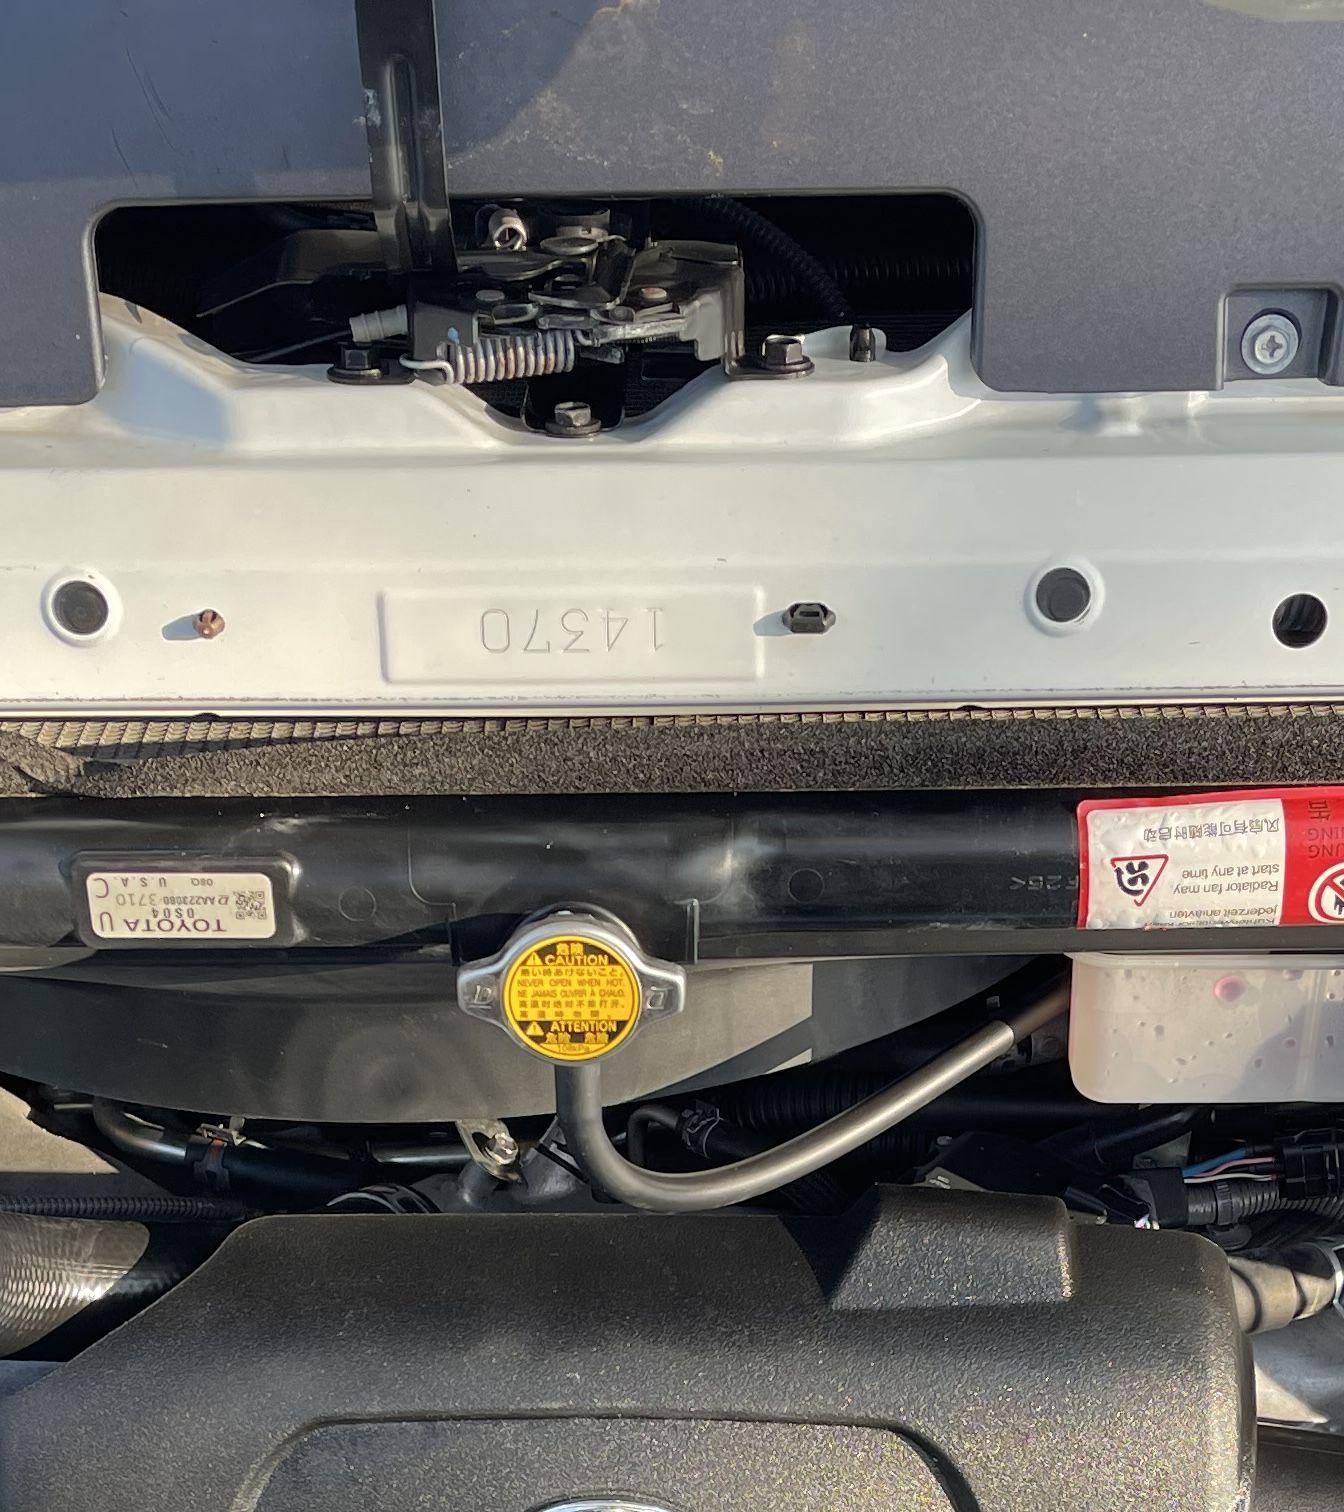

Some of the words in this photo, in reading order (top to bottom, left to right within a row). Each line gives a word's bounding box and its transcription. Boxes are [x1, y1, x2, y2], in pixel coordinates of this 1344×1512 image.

[480, 608, 666, 654] 14370
[1181, 869, 1209, 880] time
[1210, 863, 1236, 876] any
[1237, 865, 1250, 876] at
[1252, 863, 1280, 876] start
[92, 877, 109, 898] C
[1173, 882, 1201, 896] may
[1203, 883, 1224, 895] fan
[1227, 880, 1280, 892] Radiator
[1224, 904, 1278, 918] jederzeit
[99, 911, 114, 932] U
[123, 918, 226, 932] TOYOTA
[545, 954, 609, 967] CAUTION
[518, 978, 545, 988] NEVER
[549, 978, 572, 988] OPEN
[577, 978, 601, 988] WHEN
[550, 1020, 617, 1033] ATTENTION
